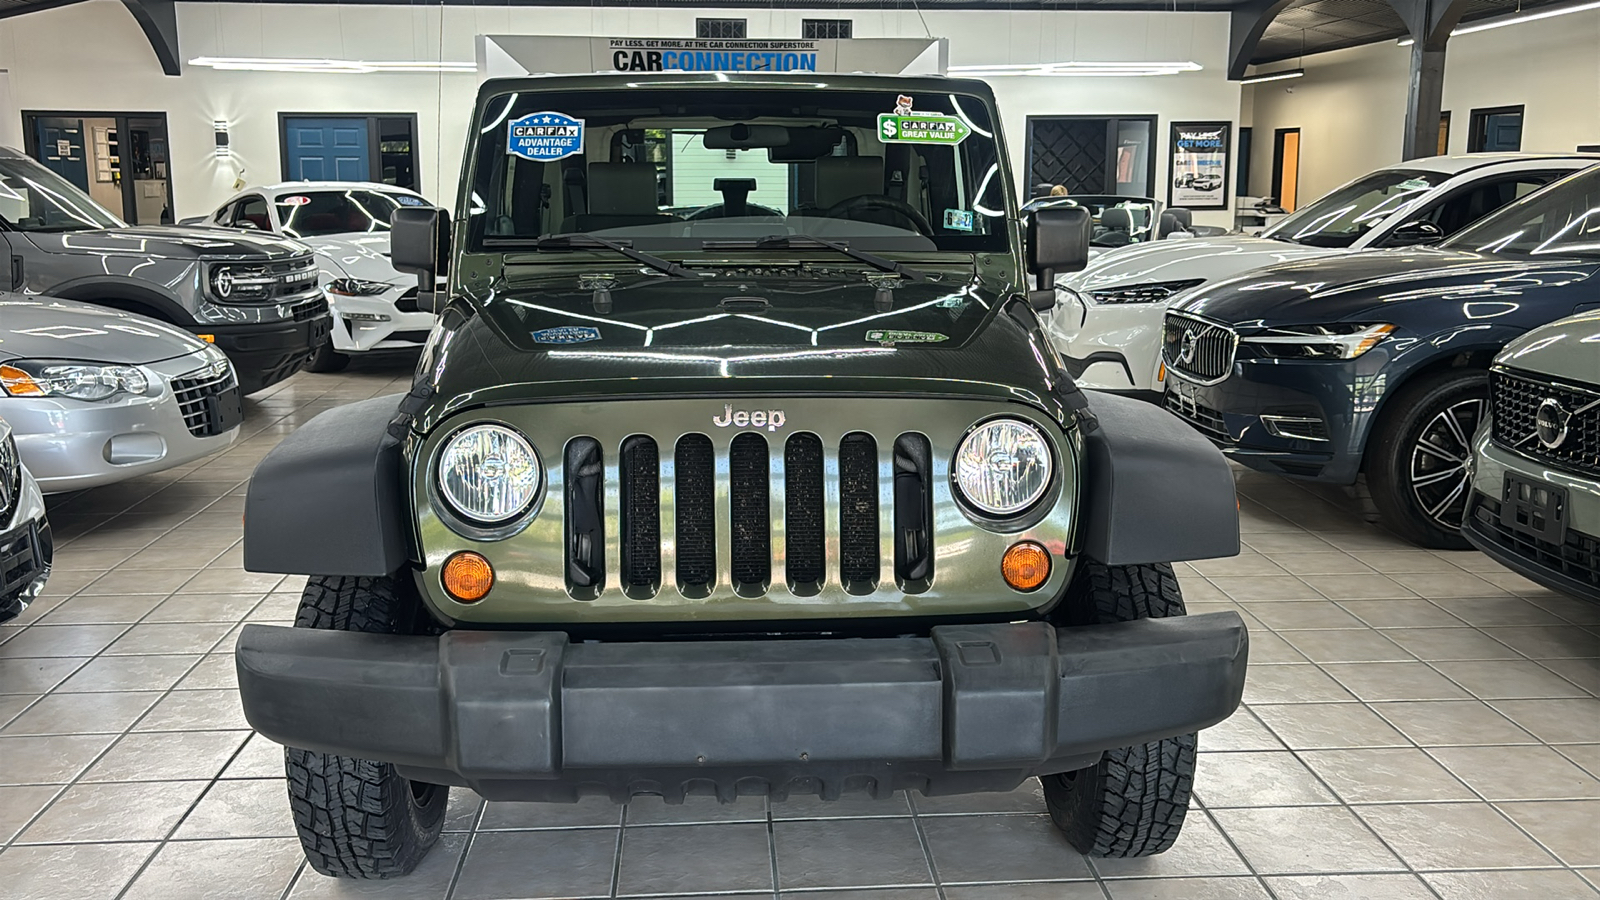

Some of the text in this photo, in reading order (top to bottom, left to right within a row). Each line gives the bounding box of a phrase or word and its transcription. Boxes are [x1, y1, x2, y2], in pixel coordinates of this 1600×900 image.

[610, 39, 623, 47] PAY
[661, 40, 684, 48] MORE.
[725, 41, 769, 49] CONNECTION
[613, 50, 817, 72] CARCONNECTION
[901, 121, 956, 131] CARFAX
[514, 126, 578, 137] CARFAX
[901, 130, 955, 139] GREAT VALUE
[518, 138, 573, 147] ADVANTAGE
[1176, 140, 1224, 148] GET MORE.
[527, 147, 563, 155] DEALER
[285, 268, 319, 283] BRONC
[712, 403, 786, 432] Jeep
[1537, 419, 1559, 430] VOLVO
